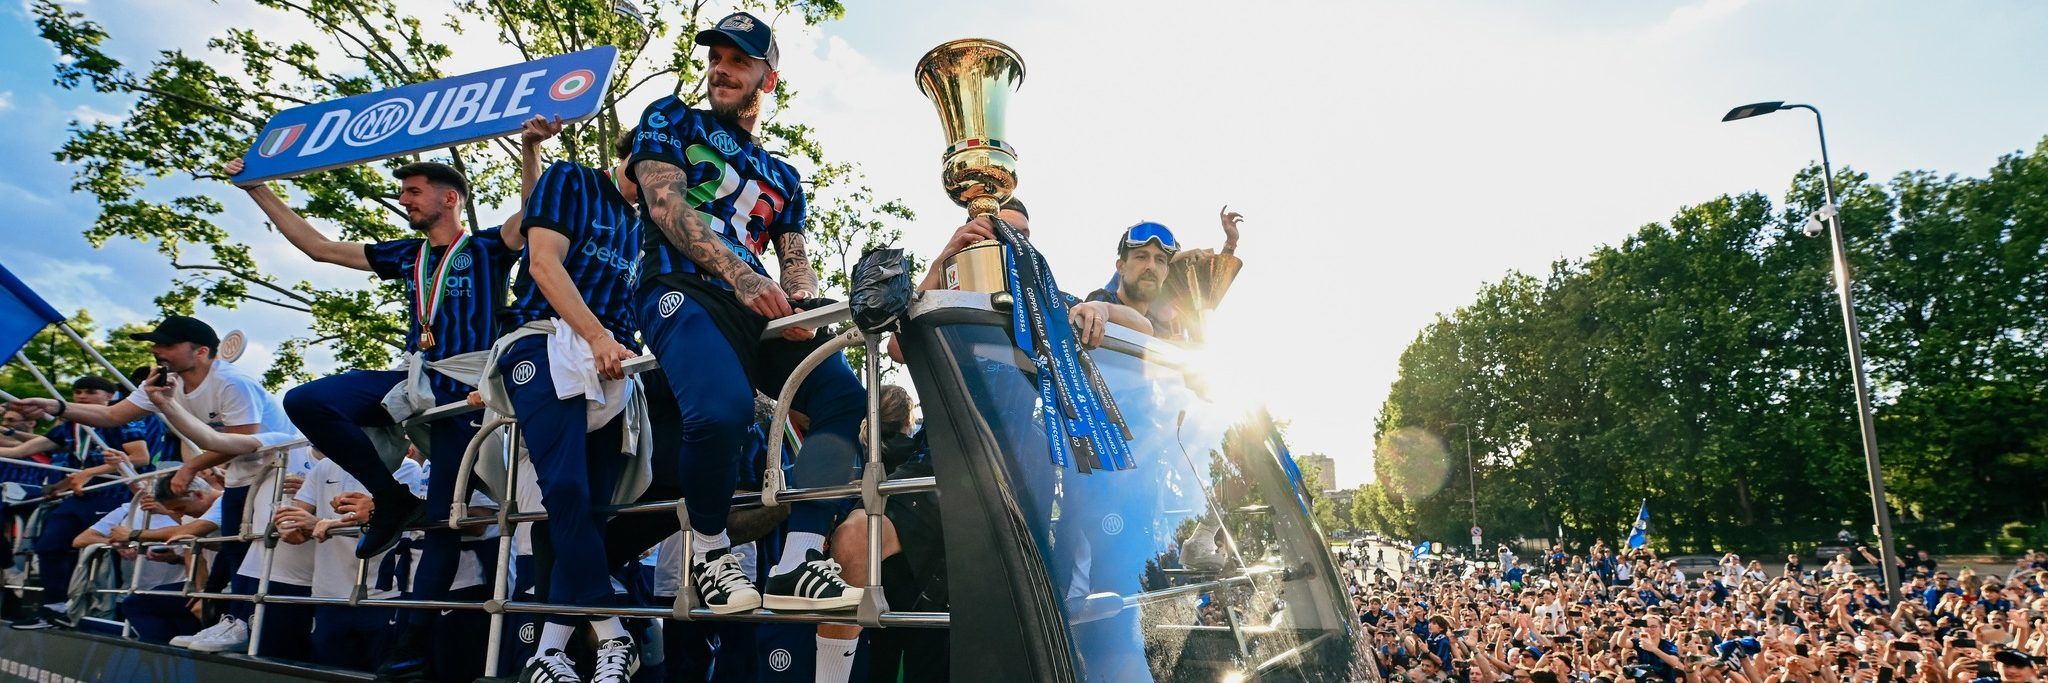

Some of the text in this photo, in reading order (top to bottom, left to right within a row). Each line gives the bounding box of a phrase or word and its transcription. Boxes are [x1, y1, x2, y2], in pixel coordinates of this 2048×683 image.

[298, 68, 548, 158] DOUBLE
[581, 236, 636, 275] betss
[1026, 287, 1039, 312] COPPA
[1035, 313, 1046, 337] ITALIA
[1061, 339, 1081, 391] FRECCIAROSSA
[1042, 380, 1052, 403] ITALIA
[1083, 405, 1096, 429] ITALIA
[1092, 429, 1105, 455] COPPA
[1105, 429, 1119, 455] COPPA
